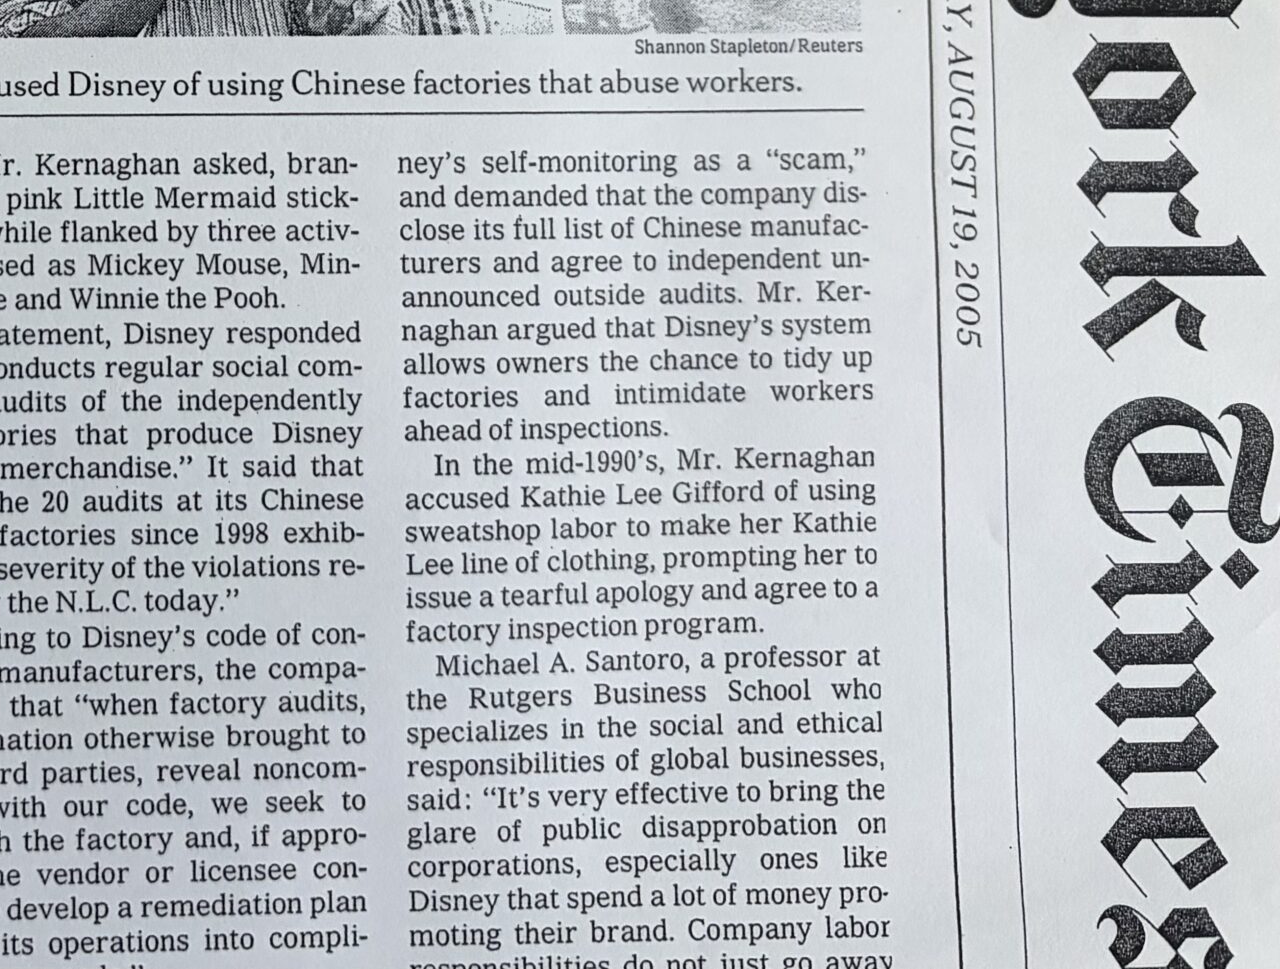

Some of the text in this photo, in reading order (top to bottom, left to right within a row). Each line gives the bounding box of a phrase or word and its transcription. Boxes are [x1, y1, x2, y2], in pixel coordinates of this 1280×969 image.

[634, 38, 706, 55] Shannon
[68, 70, 167, 104] Disney
[172, 70, 203, 97] of
[207, 71, 285, 103] using
[291, 68, 406, 96] Chinese
[413, 68, 532, 96] factories
[538, 68, 593, 95] that
[599, 67, 680, 94] abuse
[685, 66, 803, 94] workers.
[947, 40, 978, 200] AUGUST
[949, 204, 978, 250] 19,
[14, 286, 62, 312] and
[68, 286, 160, 310] Winnie
[165, 285, 207, 310] the
[213, 285, 286, 310] Pooh.
[954, 259, 983, 349] 2005
[41, 489, 69, 514] 20
[82, 489, 164, 513] audits
[176, 490, 203, 513] at
[215, 488, 248, 512] its
[260, 487, 364, 512] Chinese
[405, 614, 765, 648] factory inspection program.
[435, 644, 881, 678] Michael A. Santoro, a professor at
[1084, 395, 1280, 969] Times
[6, 895, 110, 926] develop
[117, 900, 133, 919] a
[140, 892, 303, 919] remediation
[309, 889, 368, 920] plan
[408, 881, 889, 918] Disney that spend a lot of money pro-
